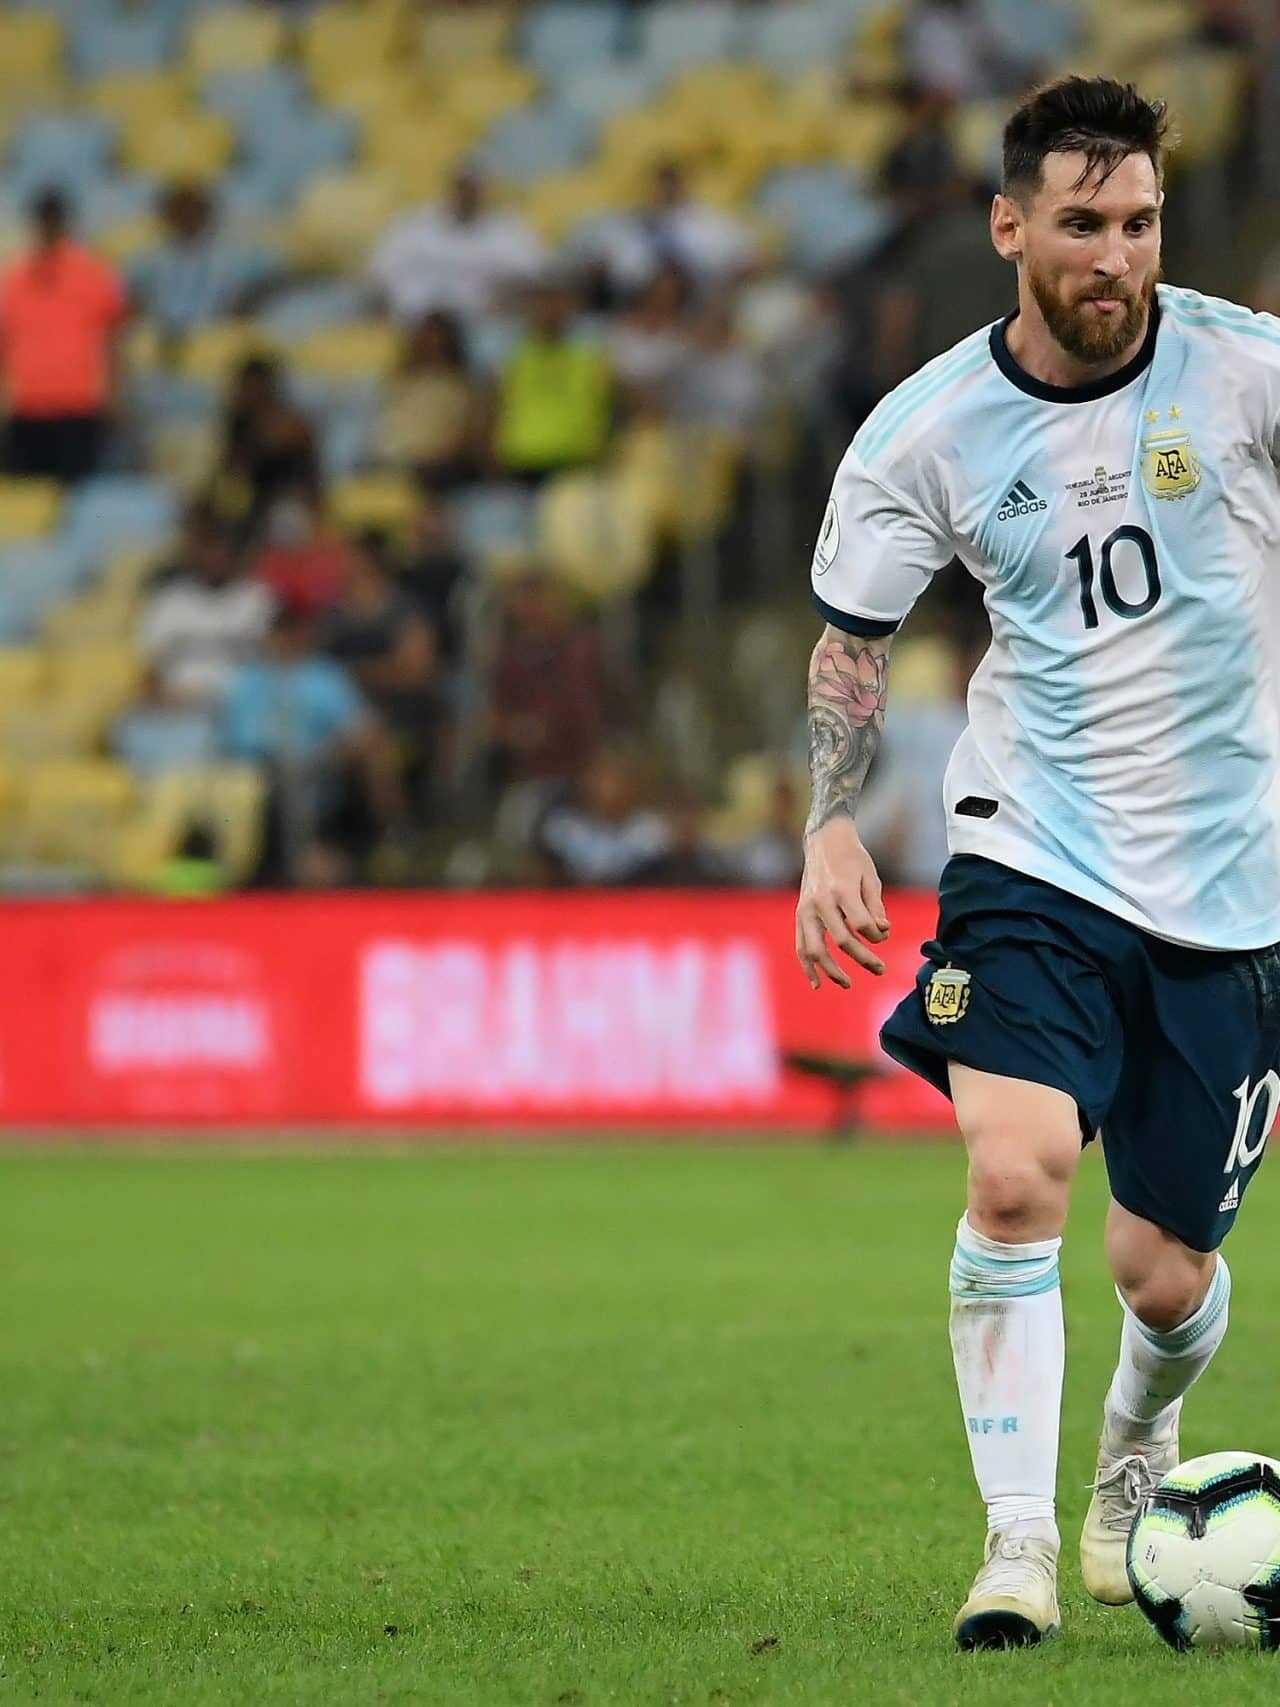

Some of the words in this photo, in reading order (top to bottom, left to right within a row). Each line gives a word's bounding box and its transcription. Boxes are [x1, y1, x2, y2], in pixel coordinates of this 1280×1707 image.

[1155, 449, 1188, 480] AFA
[997, 498, 1048, 522] adidas
[1077, 499, 1090, 507] RIO
[1064, 524, 1162, 629] 10
